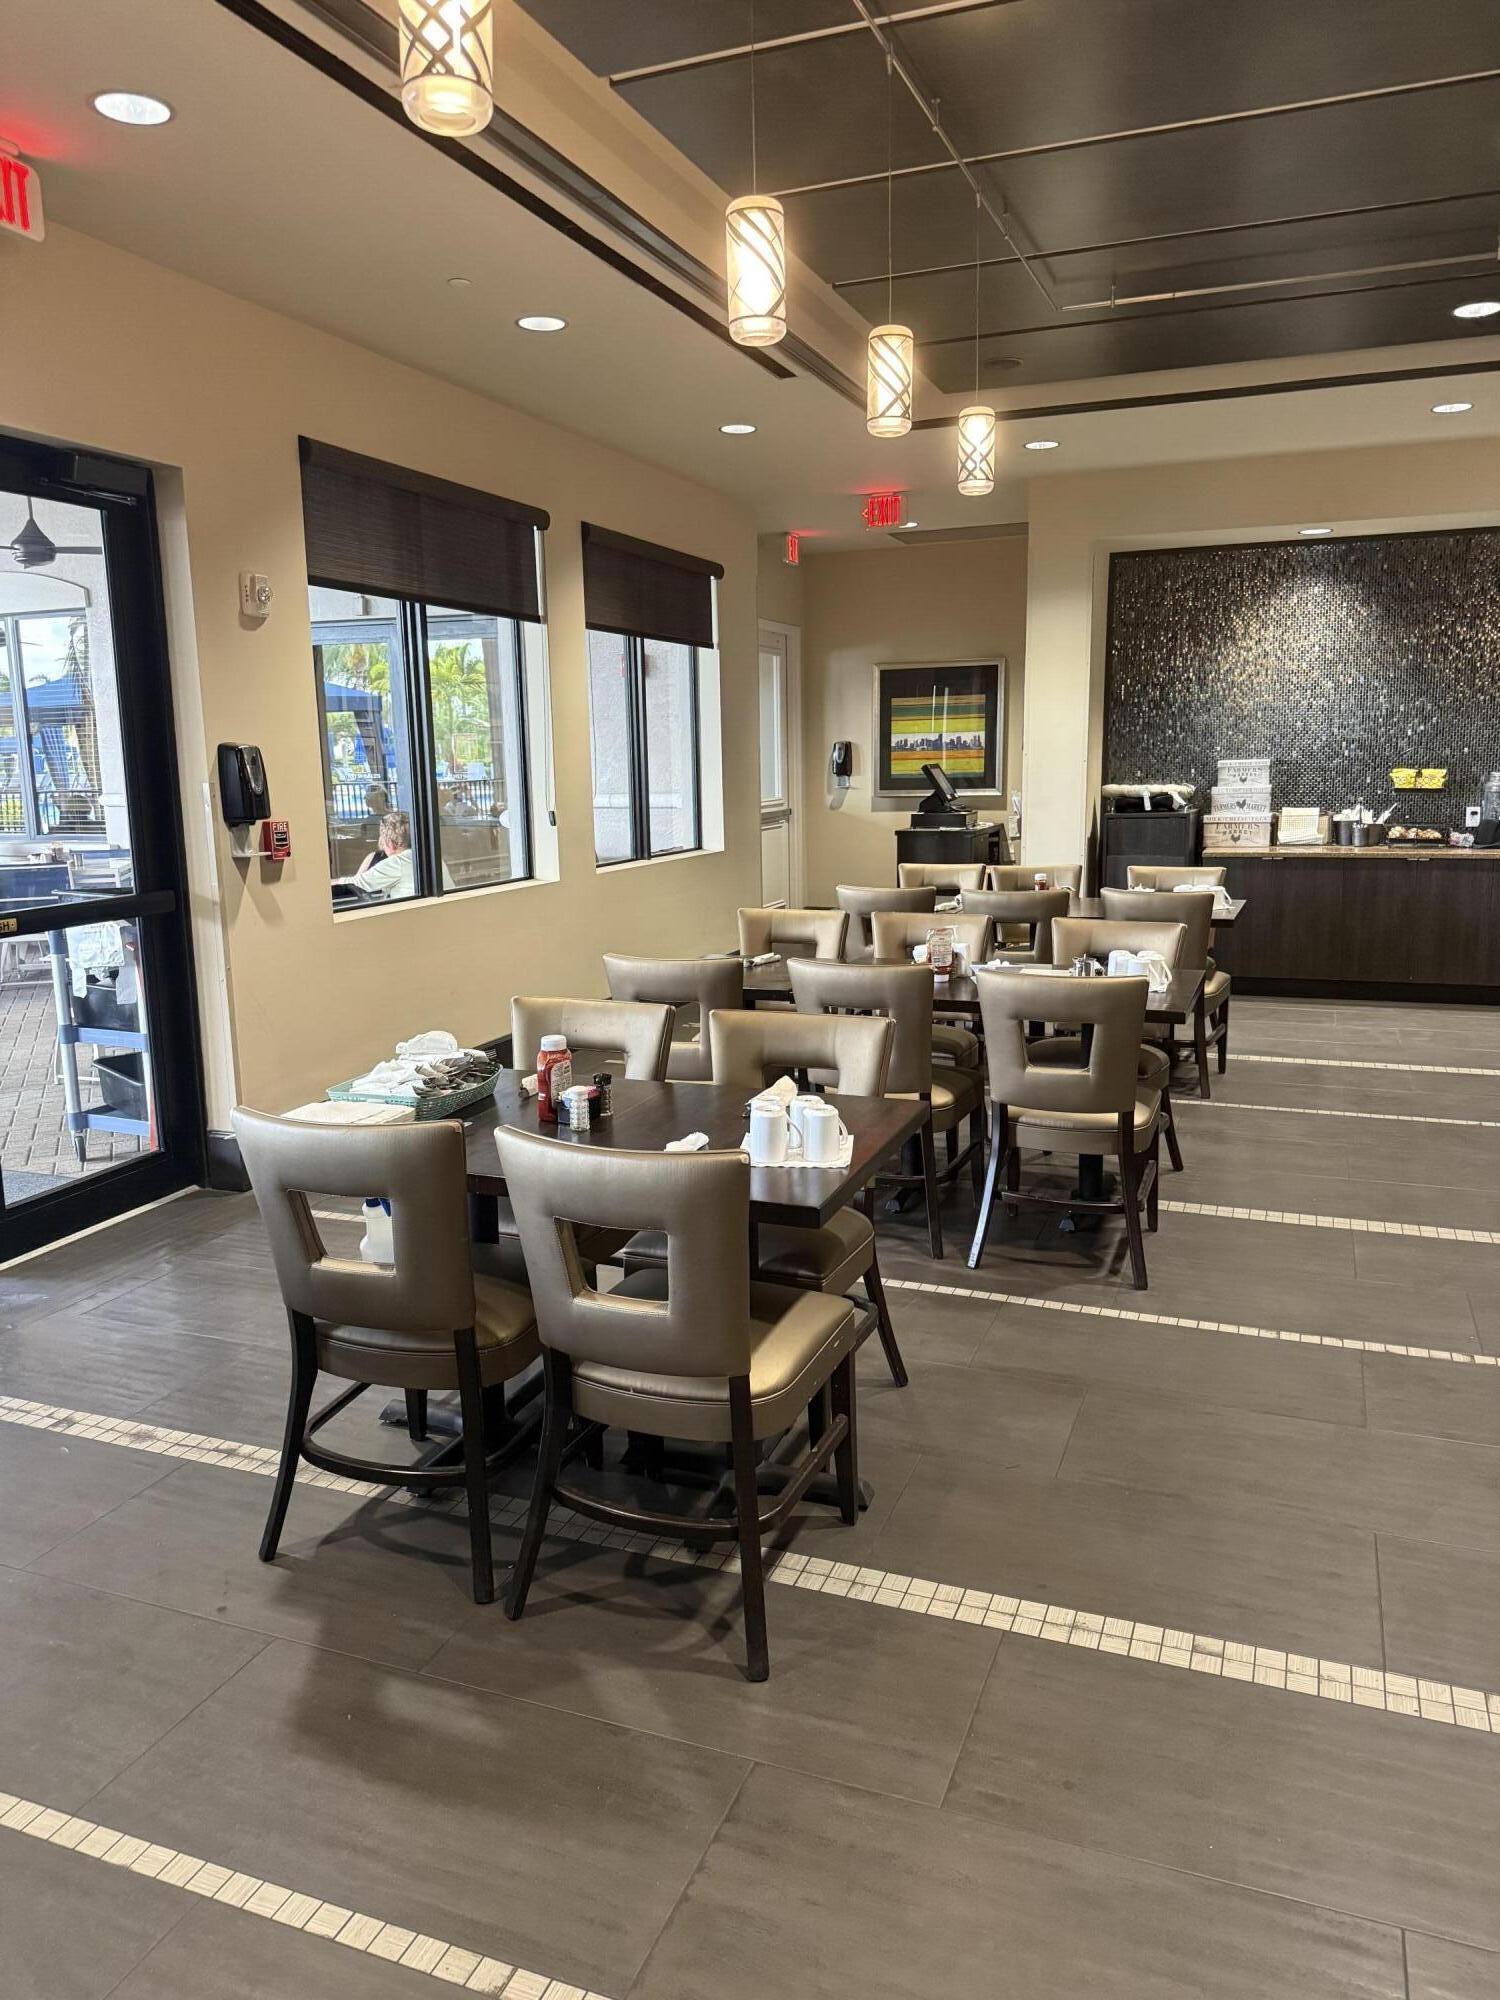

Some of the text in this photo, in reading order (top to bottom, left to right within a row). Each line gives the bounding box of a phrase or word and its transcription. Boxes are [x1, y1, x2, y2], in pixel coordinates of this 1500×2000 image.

[868, 496, 901, 526] EXIT
[1246, 803, 1266, 812] MARKET
[272, 822, 288, 831] FIRE
